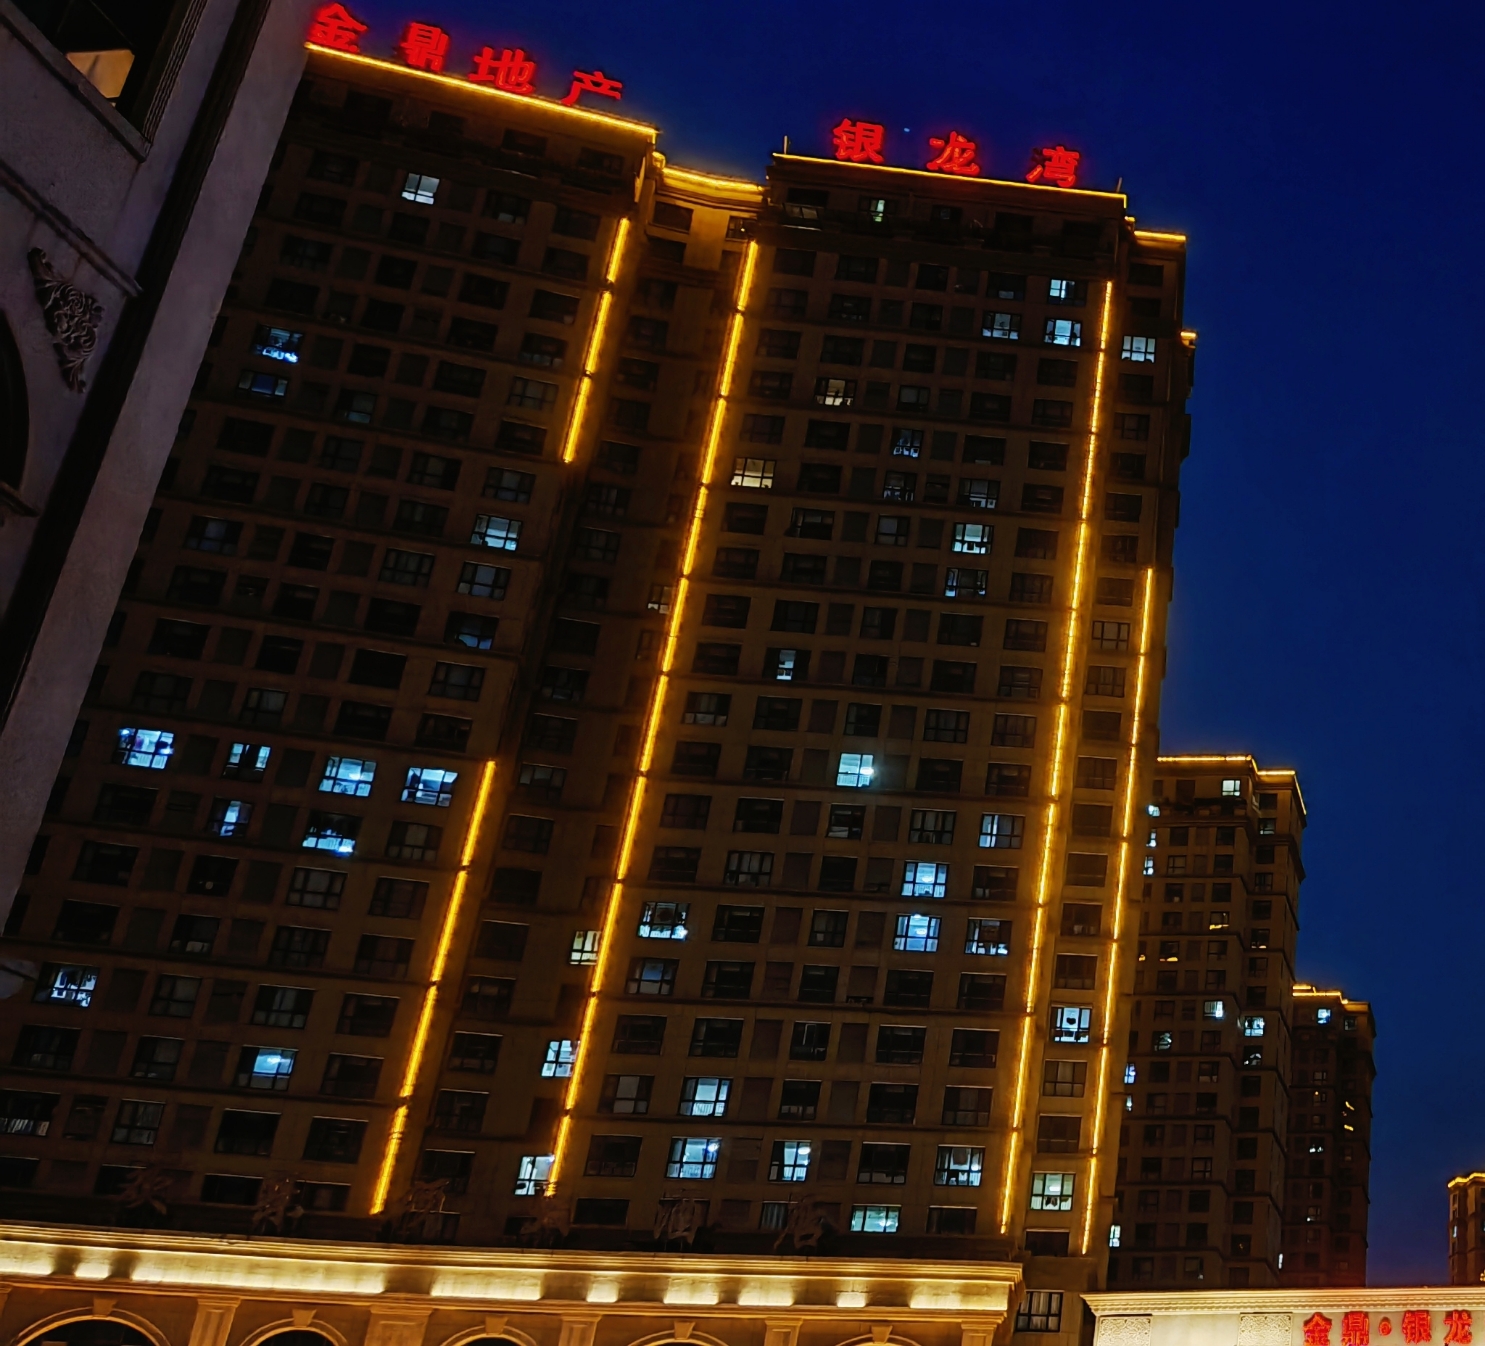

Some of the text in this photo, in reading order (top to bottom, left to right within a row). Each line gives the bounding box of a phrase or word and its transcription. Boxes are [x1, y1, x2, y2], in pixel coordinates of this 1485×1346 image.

[304, 3, 624, 106] 金鼎地产
[831, 117, 1080, 188] 银龙湾
